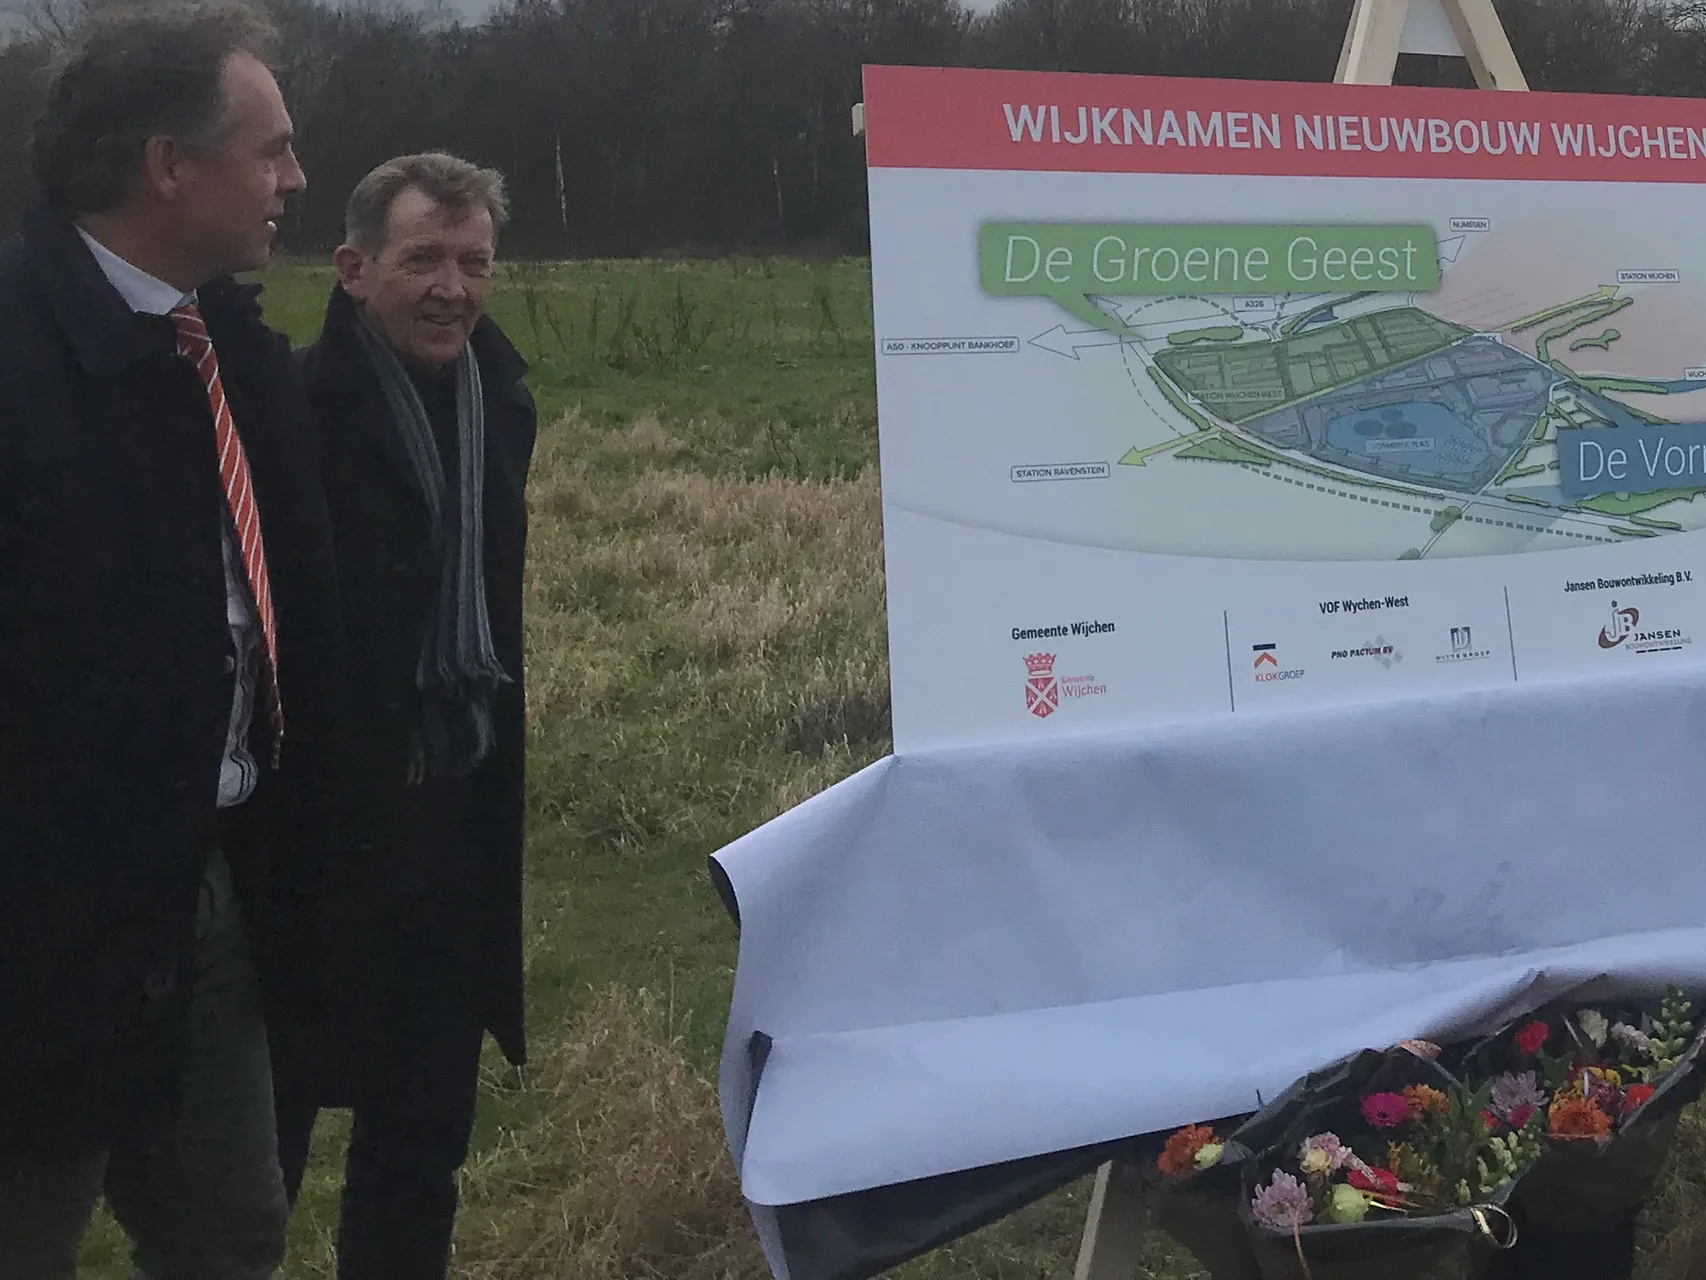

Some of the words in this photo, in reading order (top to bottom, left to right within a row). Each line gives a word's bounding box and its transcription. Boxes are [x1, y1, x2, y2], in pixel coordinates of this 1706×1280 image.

[1002, 103, 1280, 150] WIJKNAMEN
[1294, 112, 1541, 156] NIEUWBOUW
[1004, 235, 1074, 284] De
[1092, 235, 1270, 283] Groene
[1286, 235, 1419, 282] Geest
[1620, 272, 1647, 280] STATION
[1244, 300, 1265, 308] A326
[886, 342, 905, 351] A50
[910, 341, 966, 351] KNOOPPUNT
[968, 340, 1015, 350] BANKHOEF
[1578, 440, 1627, 482] De
[1016, 469, 1052, 478] STATION
[1053, 466, 1105, 476] RAVENSTEIN
[1564, 579, 1596, 593] Jansen
[1597, 572, 1675, 589] Bouwontwikkeling
[1676, 570, 1693, 583] B.V.
[1319, 601, 1341, 615] VOF
[1342, 595, 1410, 614] Wychen-West
[1011, 624, 1069, 641] Gemeente
[1070, 620, 1116, 638] Wijchen
[1634, 629, 1681, 642] JANSEN
[1331, 650, 1348, 659] PNO
[1350, 647, 1381, 657] PACTUM
[1061, 673, 1096, 685] Gemeente
[1254, 669, 1305, 683] KLOKGROEP
[1061, 682, 1107, 698] Wijchen
